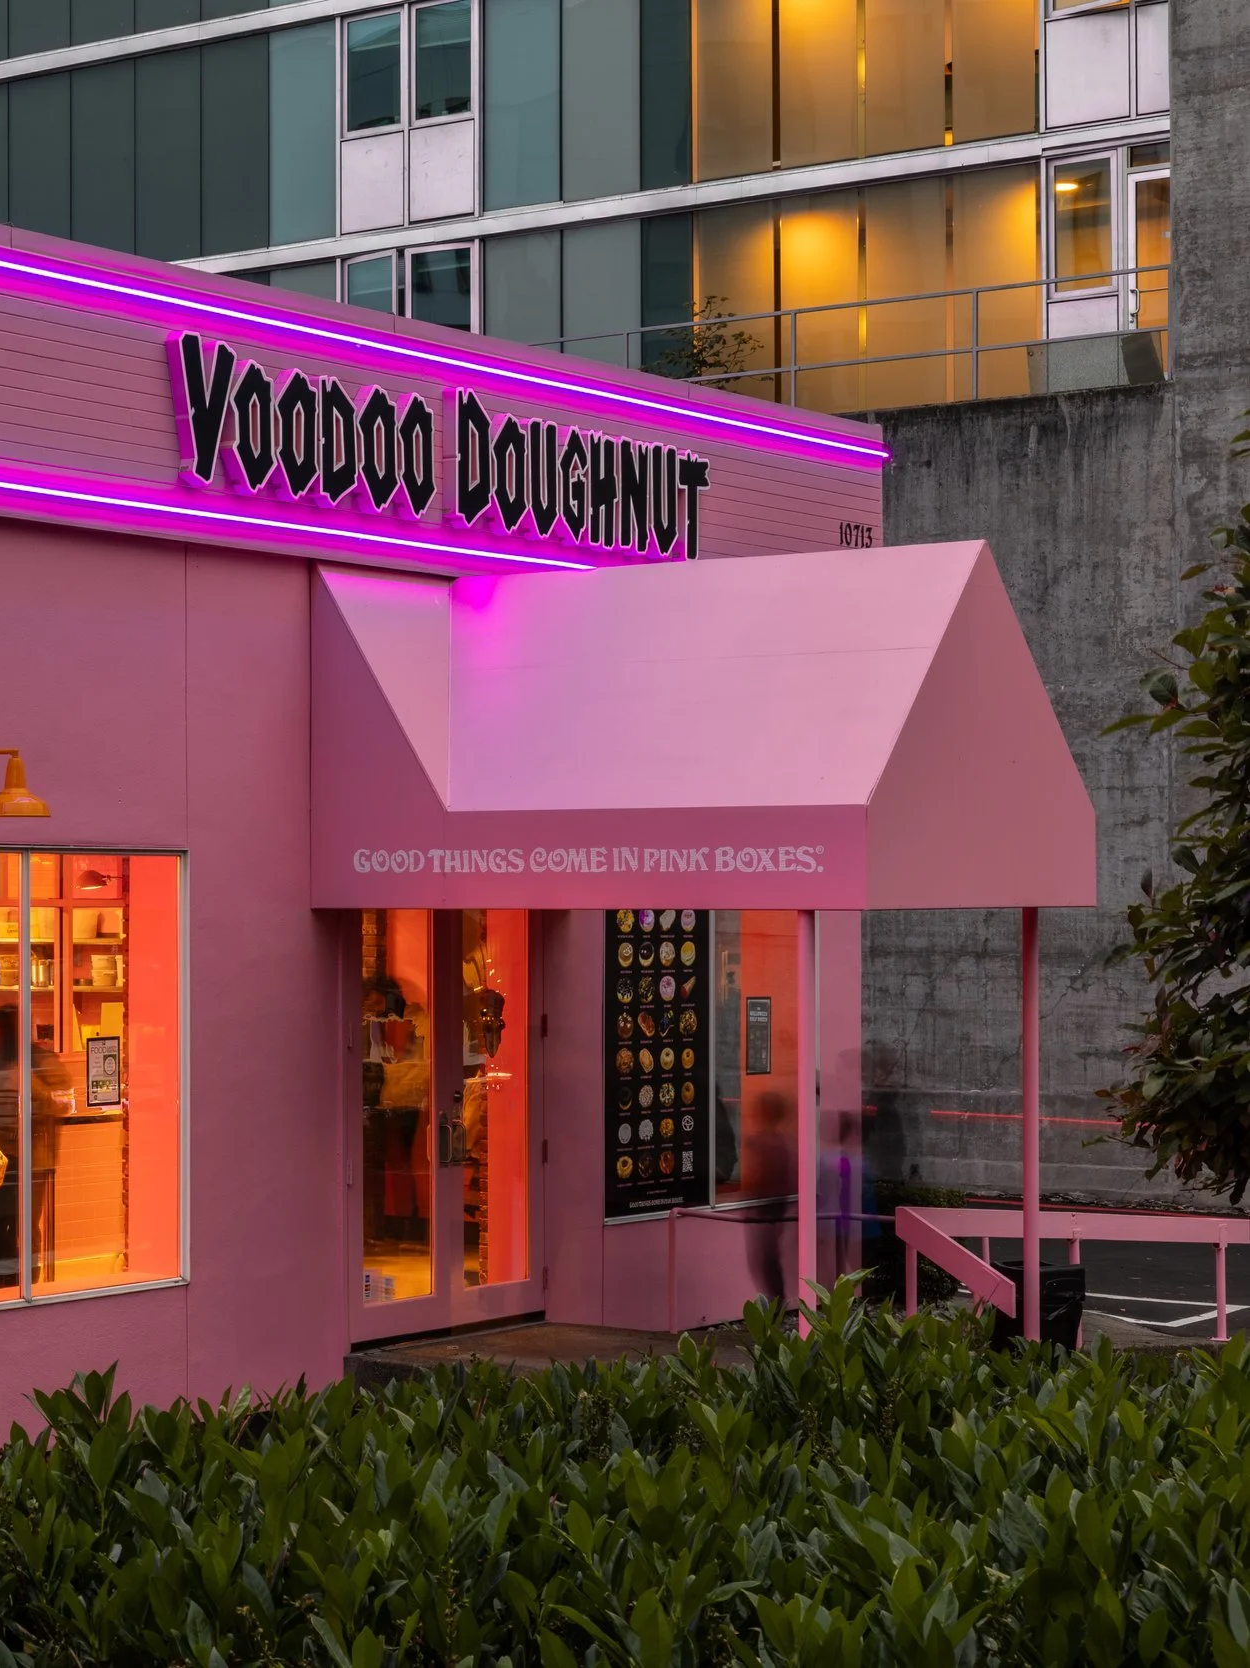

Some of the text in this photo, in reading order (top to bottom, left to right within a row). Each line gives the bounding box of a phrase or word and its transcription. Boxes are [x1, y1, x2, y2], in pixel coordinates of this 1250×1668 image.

[174, 330, 711, 561] VOODOO DOUGHNUT
[839, 522, 873, 548] 10713
[353, 848, 425, 874] GOOD
[427, 848, 526, 874] THINGS
[529, 846, 609, 874] COME
[612, 847, 639, 873] IN
[643, 847, 710, 873] PINK
